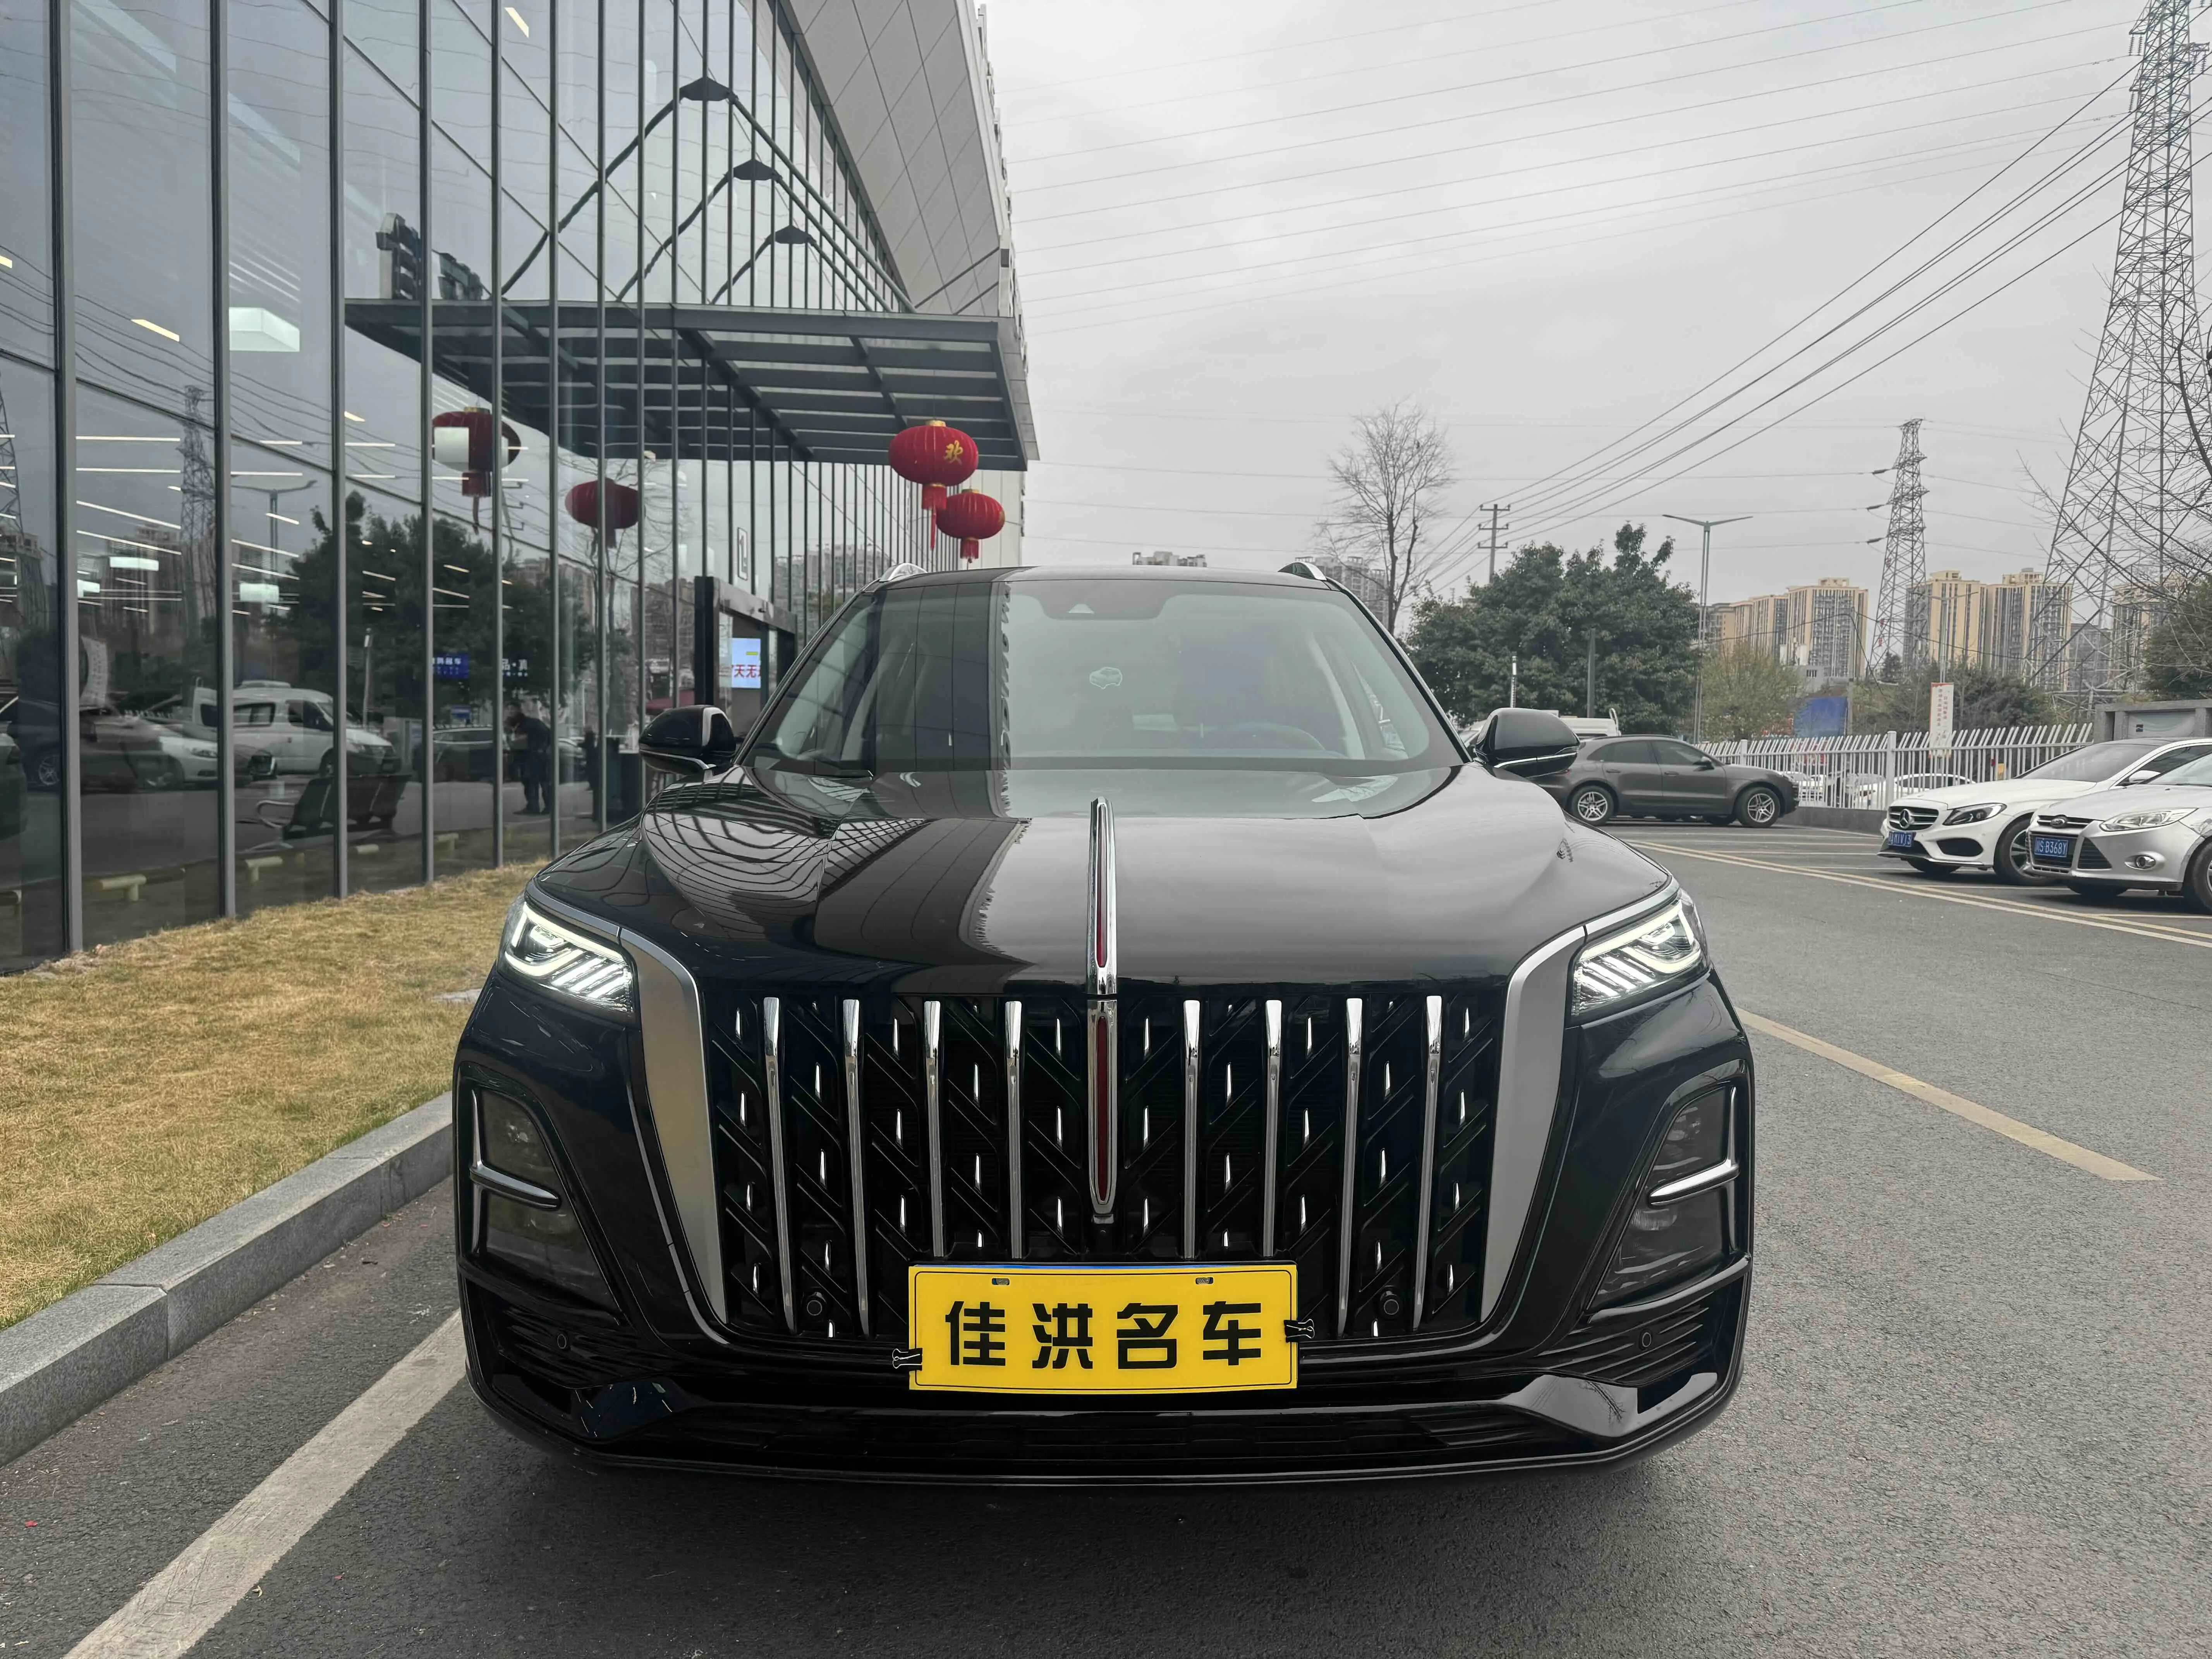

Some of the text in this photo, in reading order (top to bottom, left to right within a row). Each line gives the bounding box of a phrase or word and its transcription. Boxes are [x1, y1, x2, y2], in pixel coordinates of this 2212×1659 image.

[731, 665, 761, 678] 天无
[945, 1301, 1261, 1369] 佳洪名车
